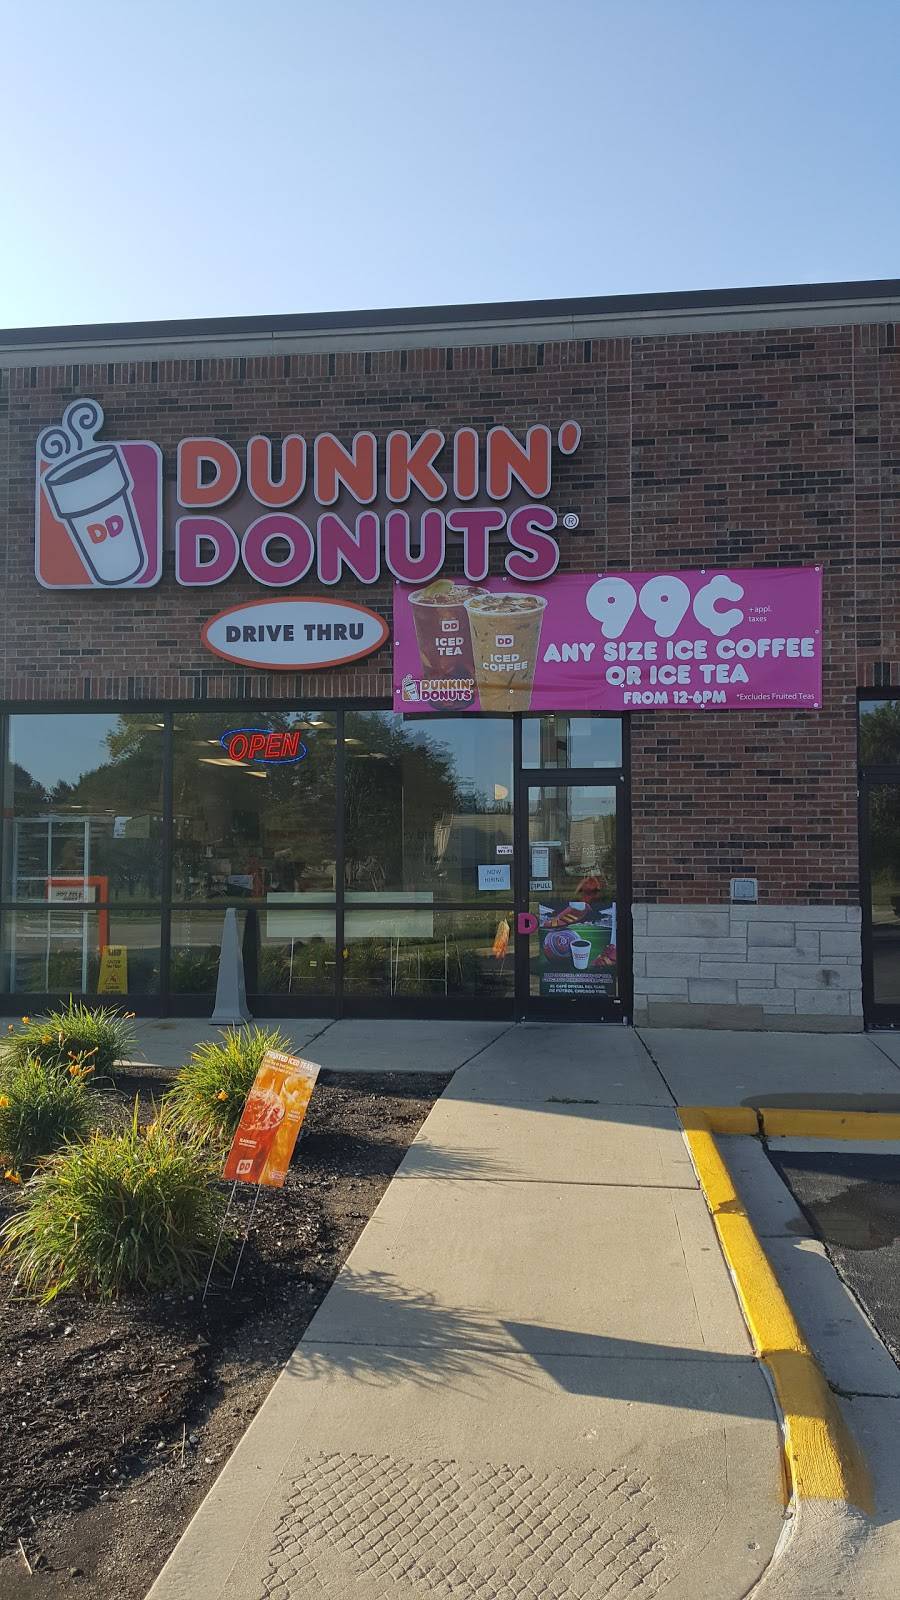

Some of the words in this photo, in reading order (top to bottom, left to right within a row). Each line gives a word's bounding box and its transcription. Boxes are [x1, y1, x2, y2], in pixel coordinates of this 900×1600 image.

[177, 420, 581, 508] DUNKIN'
[86, 514, 124, 545] DD
[175, 504, 560, 588] DONUTS
[585, 574, 745, 639] 99¢
[225, 624, 294, 643] DRIVE
[303, 622, 364, 641] THRU
[435, 637, 464, 647] ICED
[543, 642, 596, 663] ANY
[603, 641, 658, 662] SIZE
[666, 639, 708, 660] ICE
[716, 637, 815, 659] COFFEE
[437, 647, 463, 656] TEA
[490, 653, 520, 662] ICED
[482, 661, 529, 672] COFFEE
[605, 665, 642, 686] OR
[649, 664, 691, 685] ICE
[699, 663, 749, 684] TEA
[420, 678, 475, 691] DUNKIN'
[420, 689, 472, 701] DONUTS
[623, 691, 668, 705] FROM
[672, 690, 727, 704] 12-6PM
[771, 692, 797, 700] Fruited
[798, 692, 815, 700] Teas
[228, 731, 302, 761] OPEN
